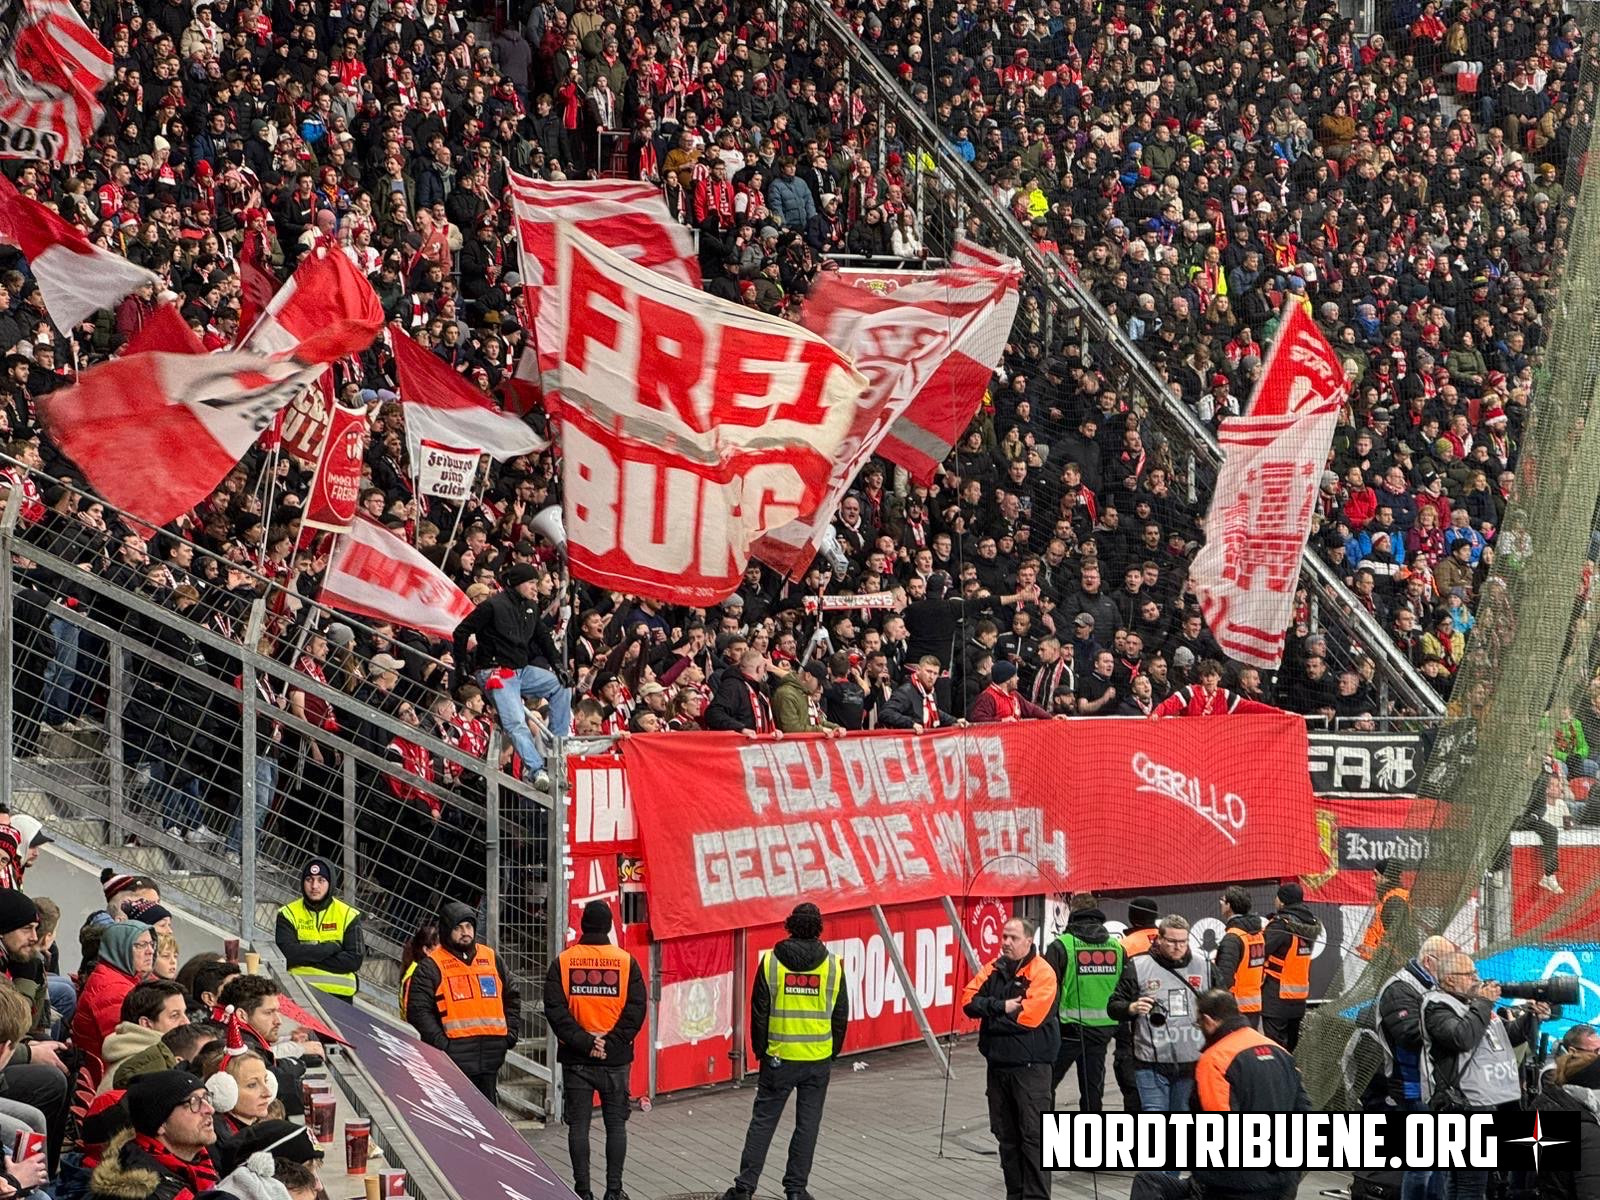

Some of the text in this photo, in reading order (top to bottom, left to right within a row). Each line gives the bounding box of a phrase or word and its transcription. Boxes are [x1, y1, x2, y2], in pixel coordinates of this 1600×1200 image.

[564, 244, 849, 434] FREI
[562, 420, 807, 578] BURG
[738, 736, 1011, 815] FICK DICH DFB
[692, 808, 1069, 907] GEGEN DIE WM 2034
[569, 957, 594, 967] SECURITY
[599, 958, 621, 968] SERVICE
[1079, 965, 1116, 974] SECURITAS
[571, 985, 618, 995] SECURITAS
[785, 986, 819, 995] SECURITAS
